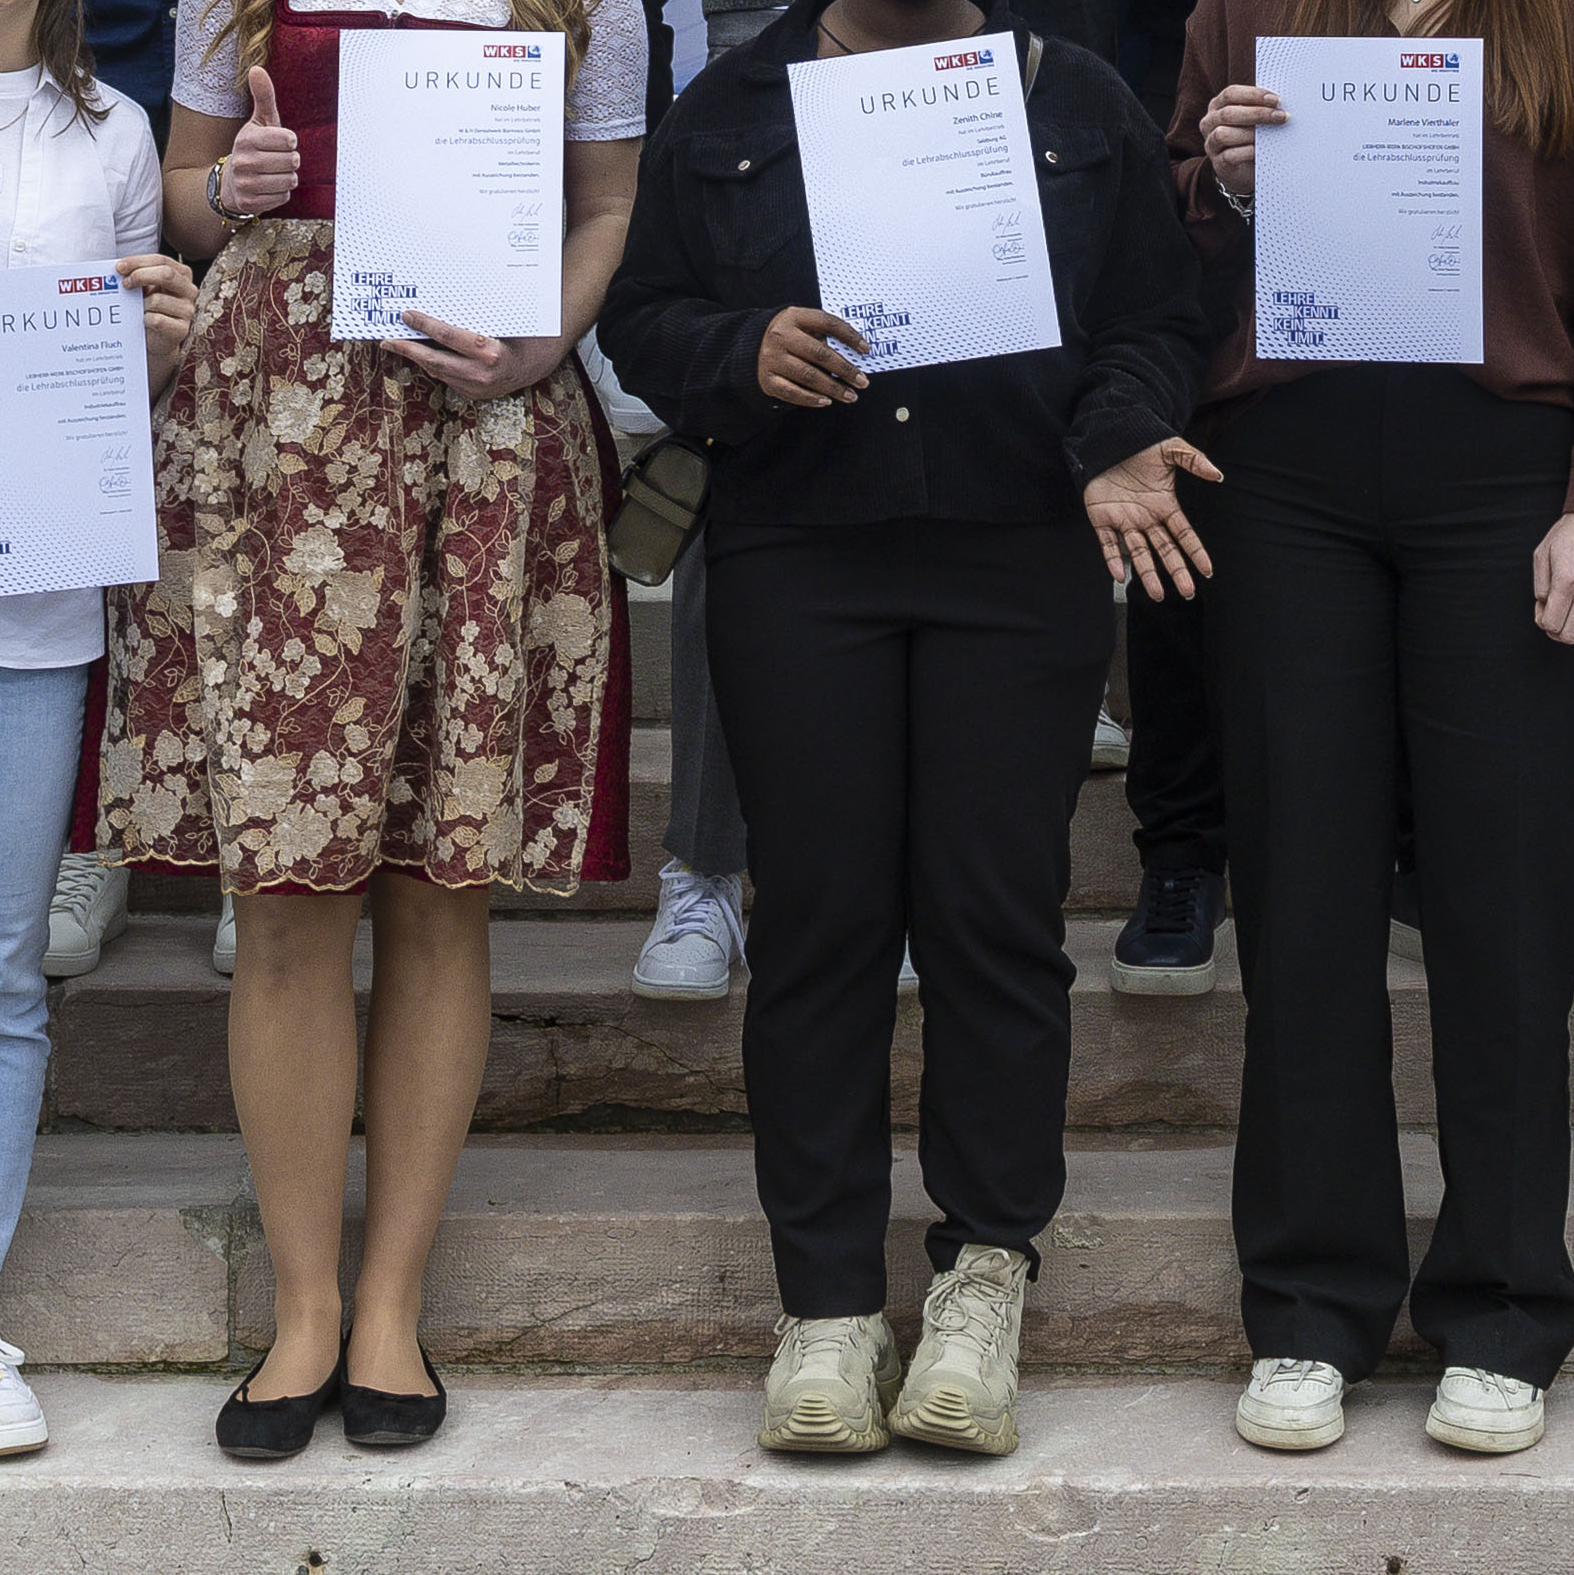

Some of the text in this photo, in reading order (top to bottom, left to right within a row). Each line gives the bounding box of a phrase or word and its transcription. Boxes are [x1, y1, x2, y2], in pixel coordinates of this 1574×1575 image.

[484, 45, 525, 57] WKS
[934, 52, 977, 70] WKS
[1401, 54, 1443, 67] WKS
[404, 71, 542, 89] URKUNDE
[860, 76, 1000, 115] URKUNDE
[1321, 81, 1460, 103] URKUNDE
[490, 104, 540, 112] Nicole Huber
[952, 113, 979, 125] Zenith
[1387, 117, 1420, 126] Marlene
[58, 277, 101, 293] WKS
[351, 272, 394, 285] LEHRE
[370, 285, 417, 298] KENNT
[1273, 291, 1314, 305] LEHRE
[350, 297, 381, 311] KEIN
[841, 302, 884, 320] LEHRE
[1294, 305, 1339, 318] KENNT
[863, 311, 910, 331] KENNT
[1274, 318, 1304, 330] KEIN
[61, 339, 122, 353] Valentina Fluch
